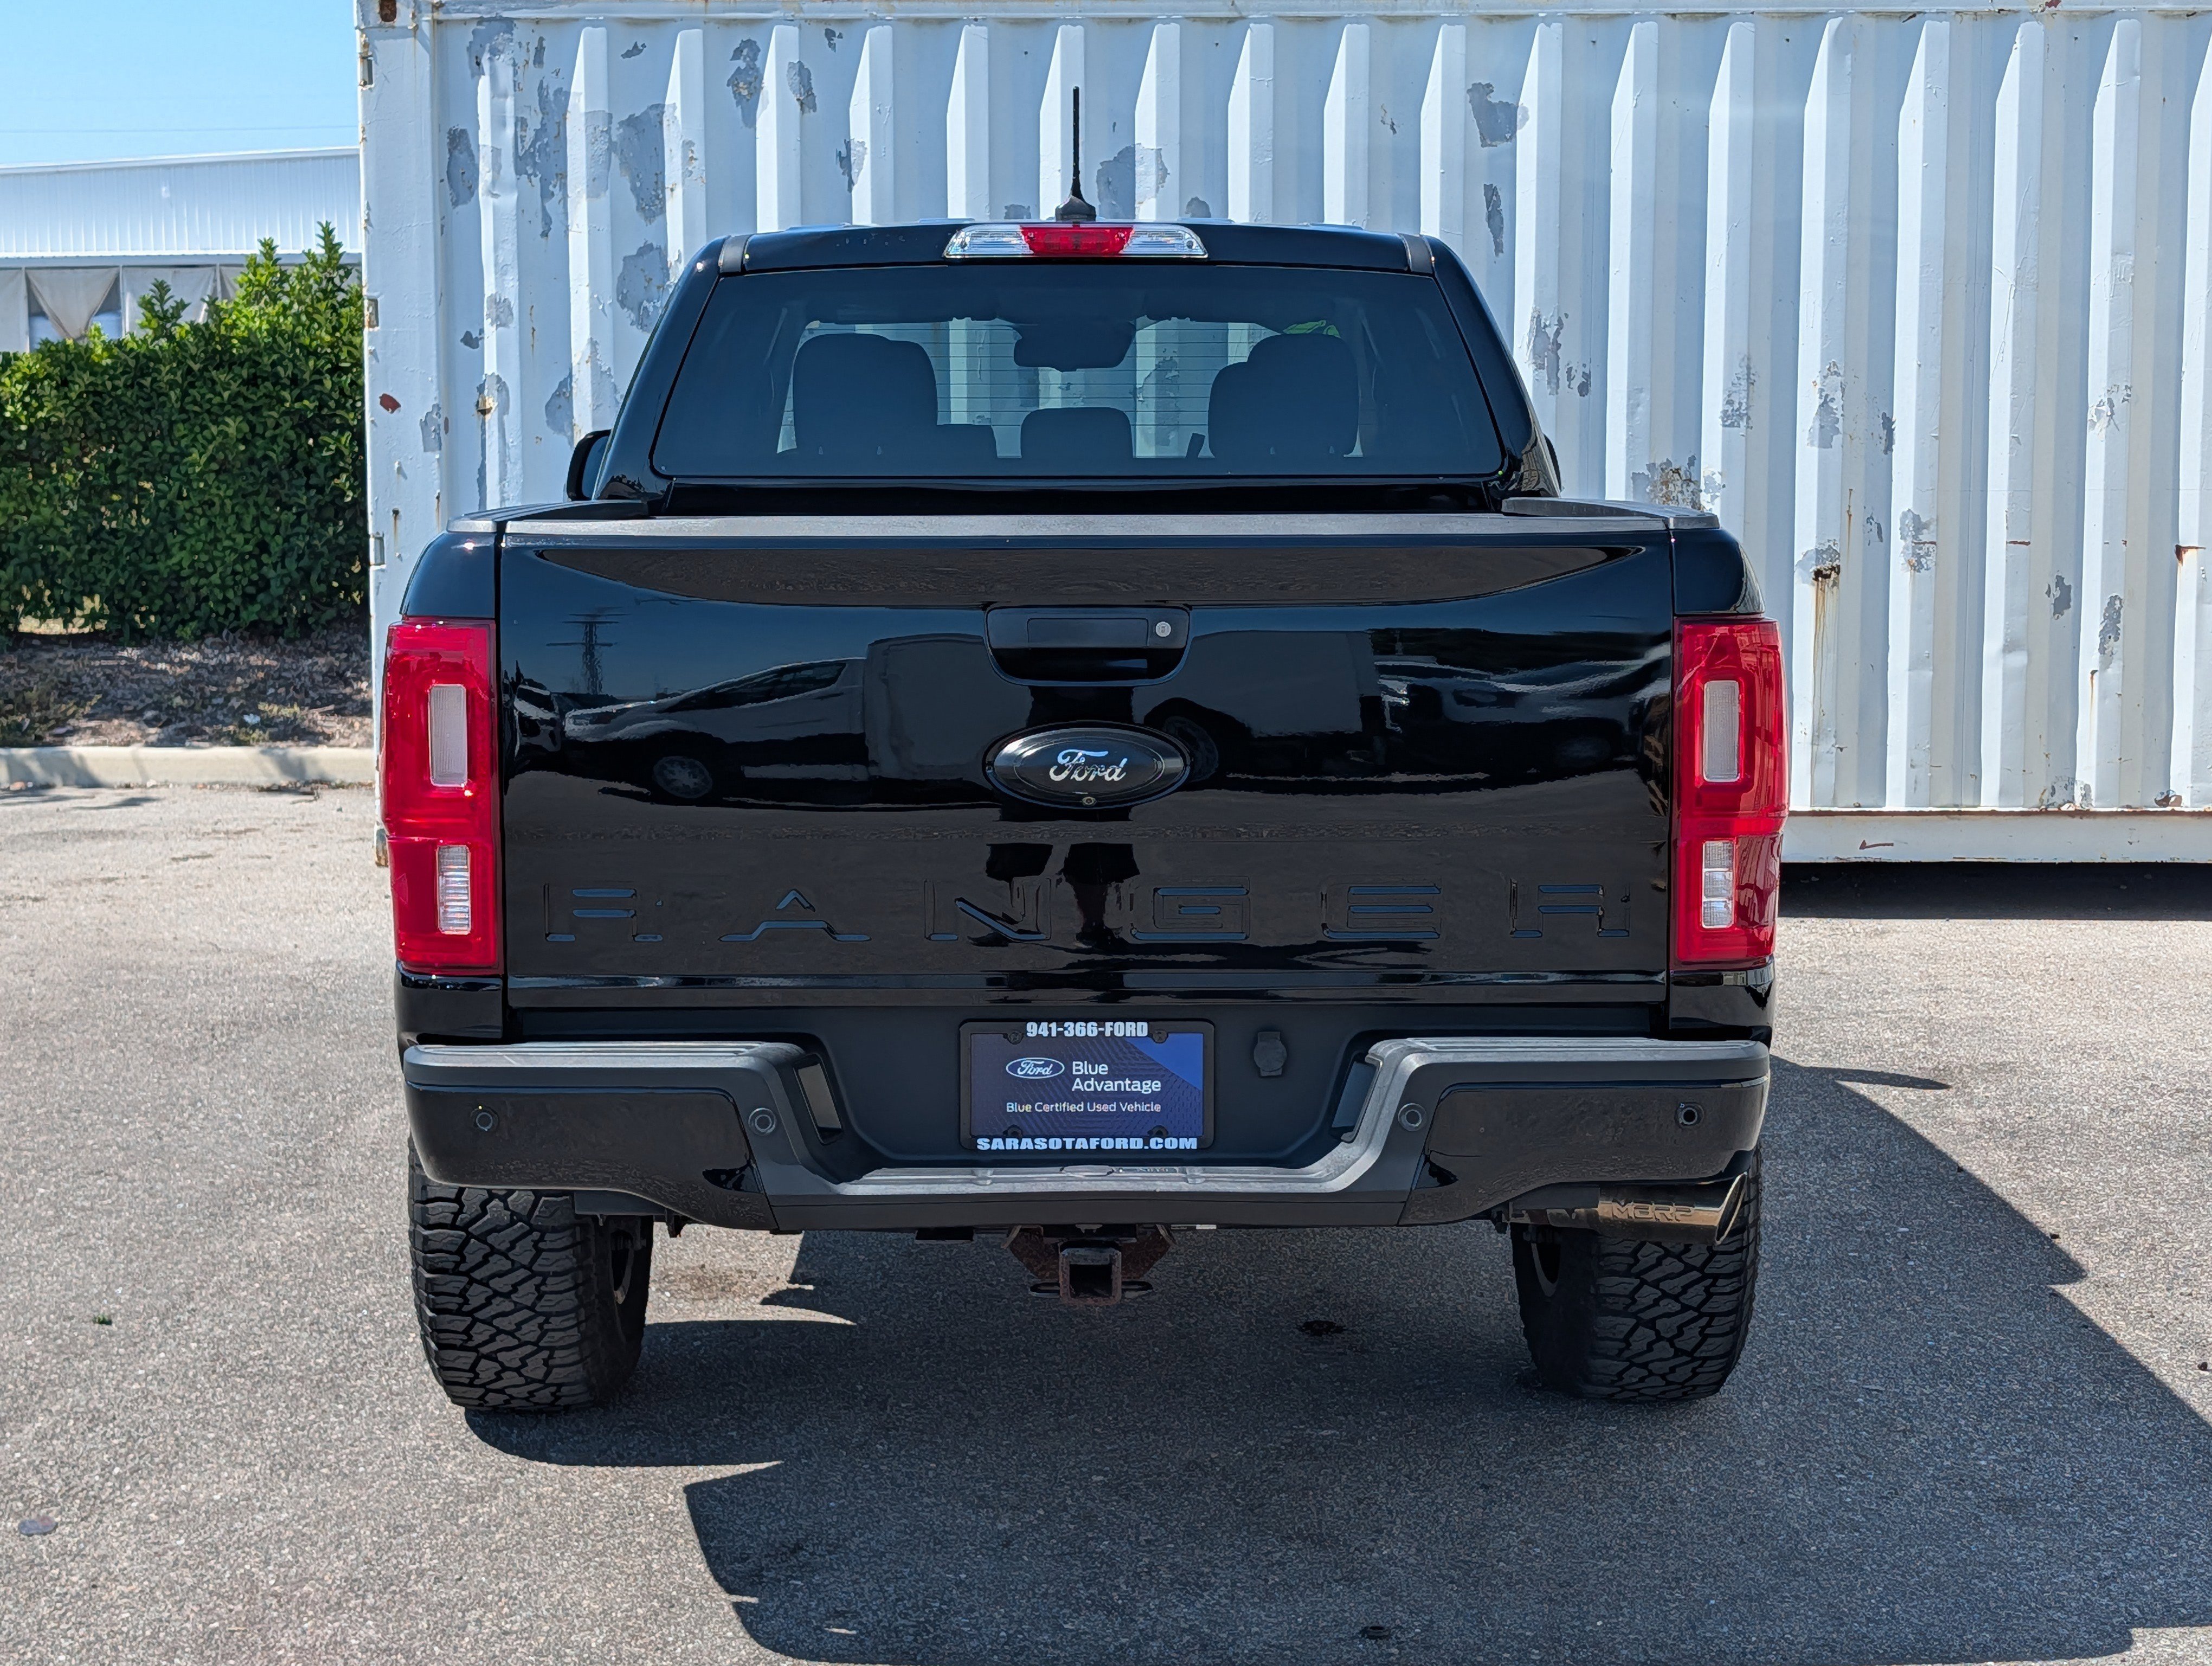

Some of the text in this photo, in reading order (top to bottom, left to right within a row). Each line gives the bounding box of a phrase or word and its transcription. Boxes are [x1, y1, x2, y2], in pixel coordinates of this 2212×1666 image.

[1049, 749, 1128, 781] Ford
[544, 877, 1630, 941] RANGER
[1026, 1022, 1148, 1037] 941-366-FORD
[1017, 1060, 1053, 1076] Ford
[1072, 1061, 1109, 1075] Blue
[1071, 1077, 1161, 1094] Advantage
[1006, 1101, 1161, 1112] Blue Certified Used Vehicle
[976, 1138, 1198, 1150] SARASOTAFORD.COM
